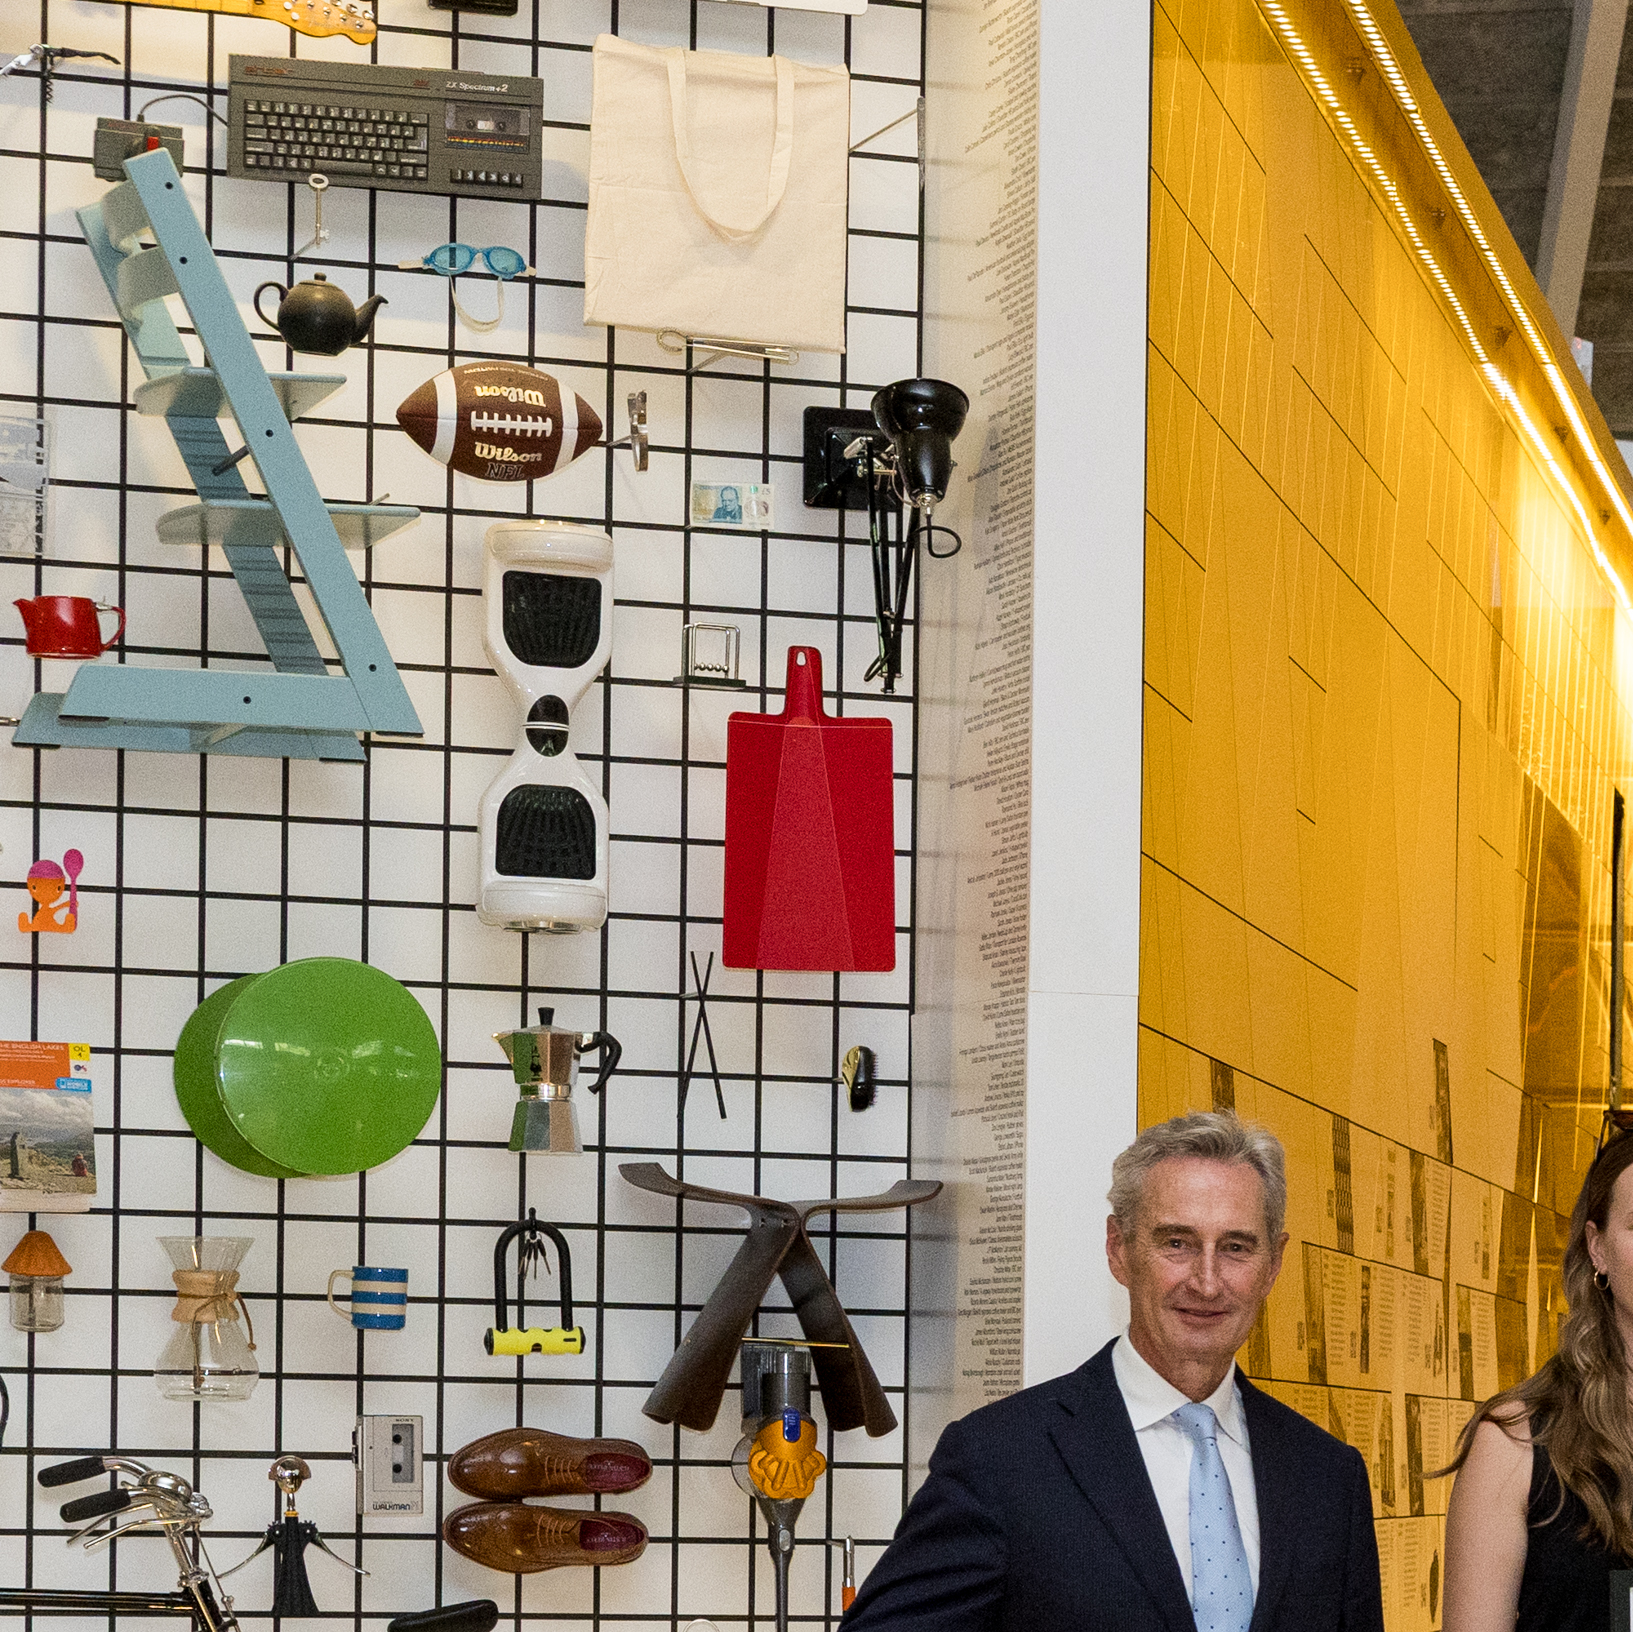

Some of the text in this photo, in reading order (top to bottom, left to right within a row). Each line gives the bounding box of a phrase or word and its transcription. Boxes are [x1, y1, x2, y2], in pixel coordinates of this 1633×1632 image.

[474, 385, 546, 408] Wilson
[475, 442, 542, 462] Wilson
[485, 462, 524, 480] NFL
